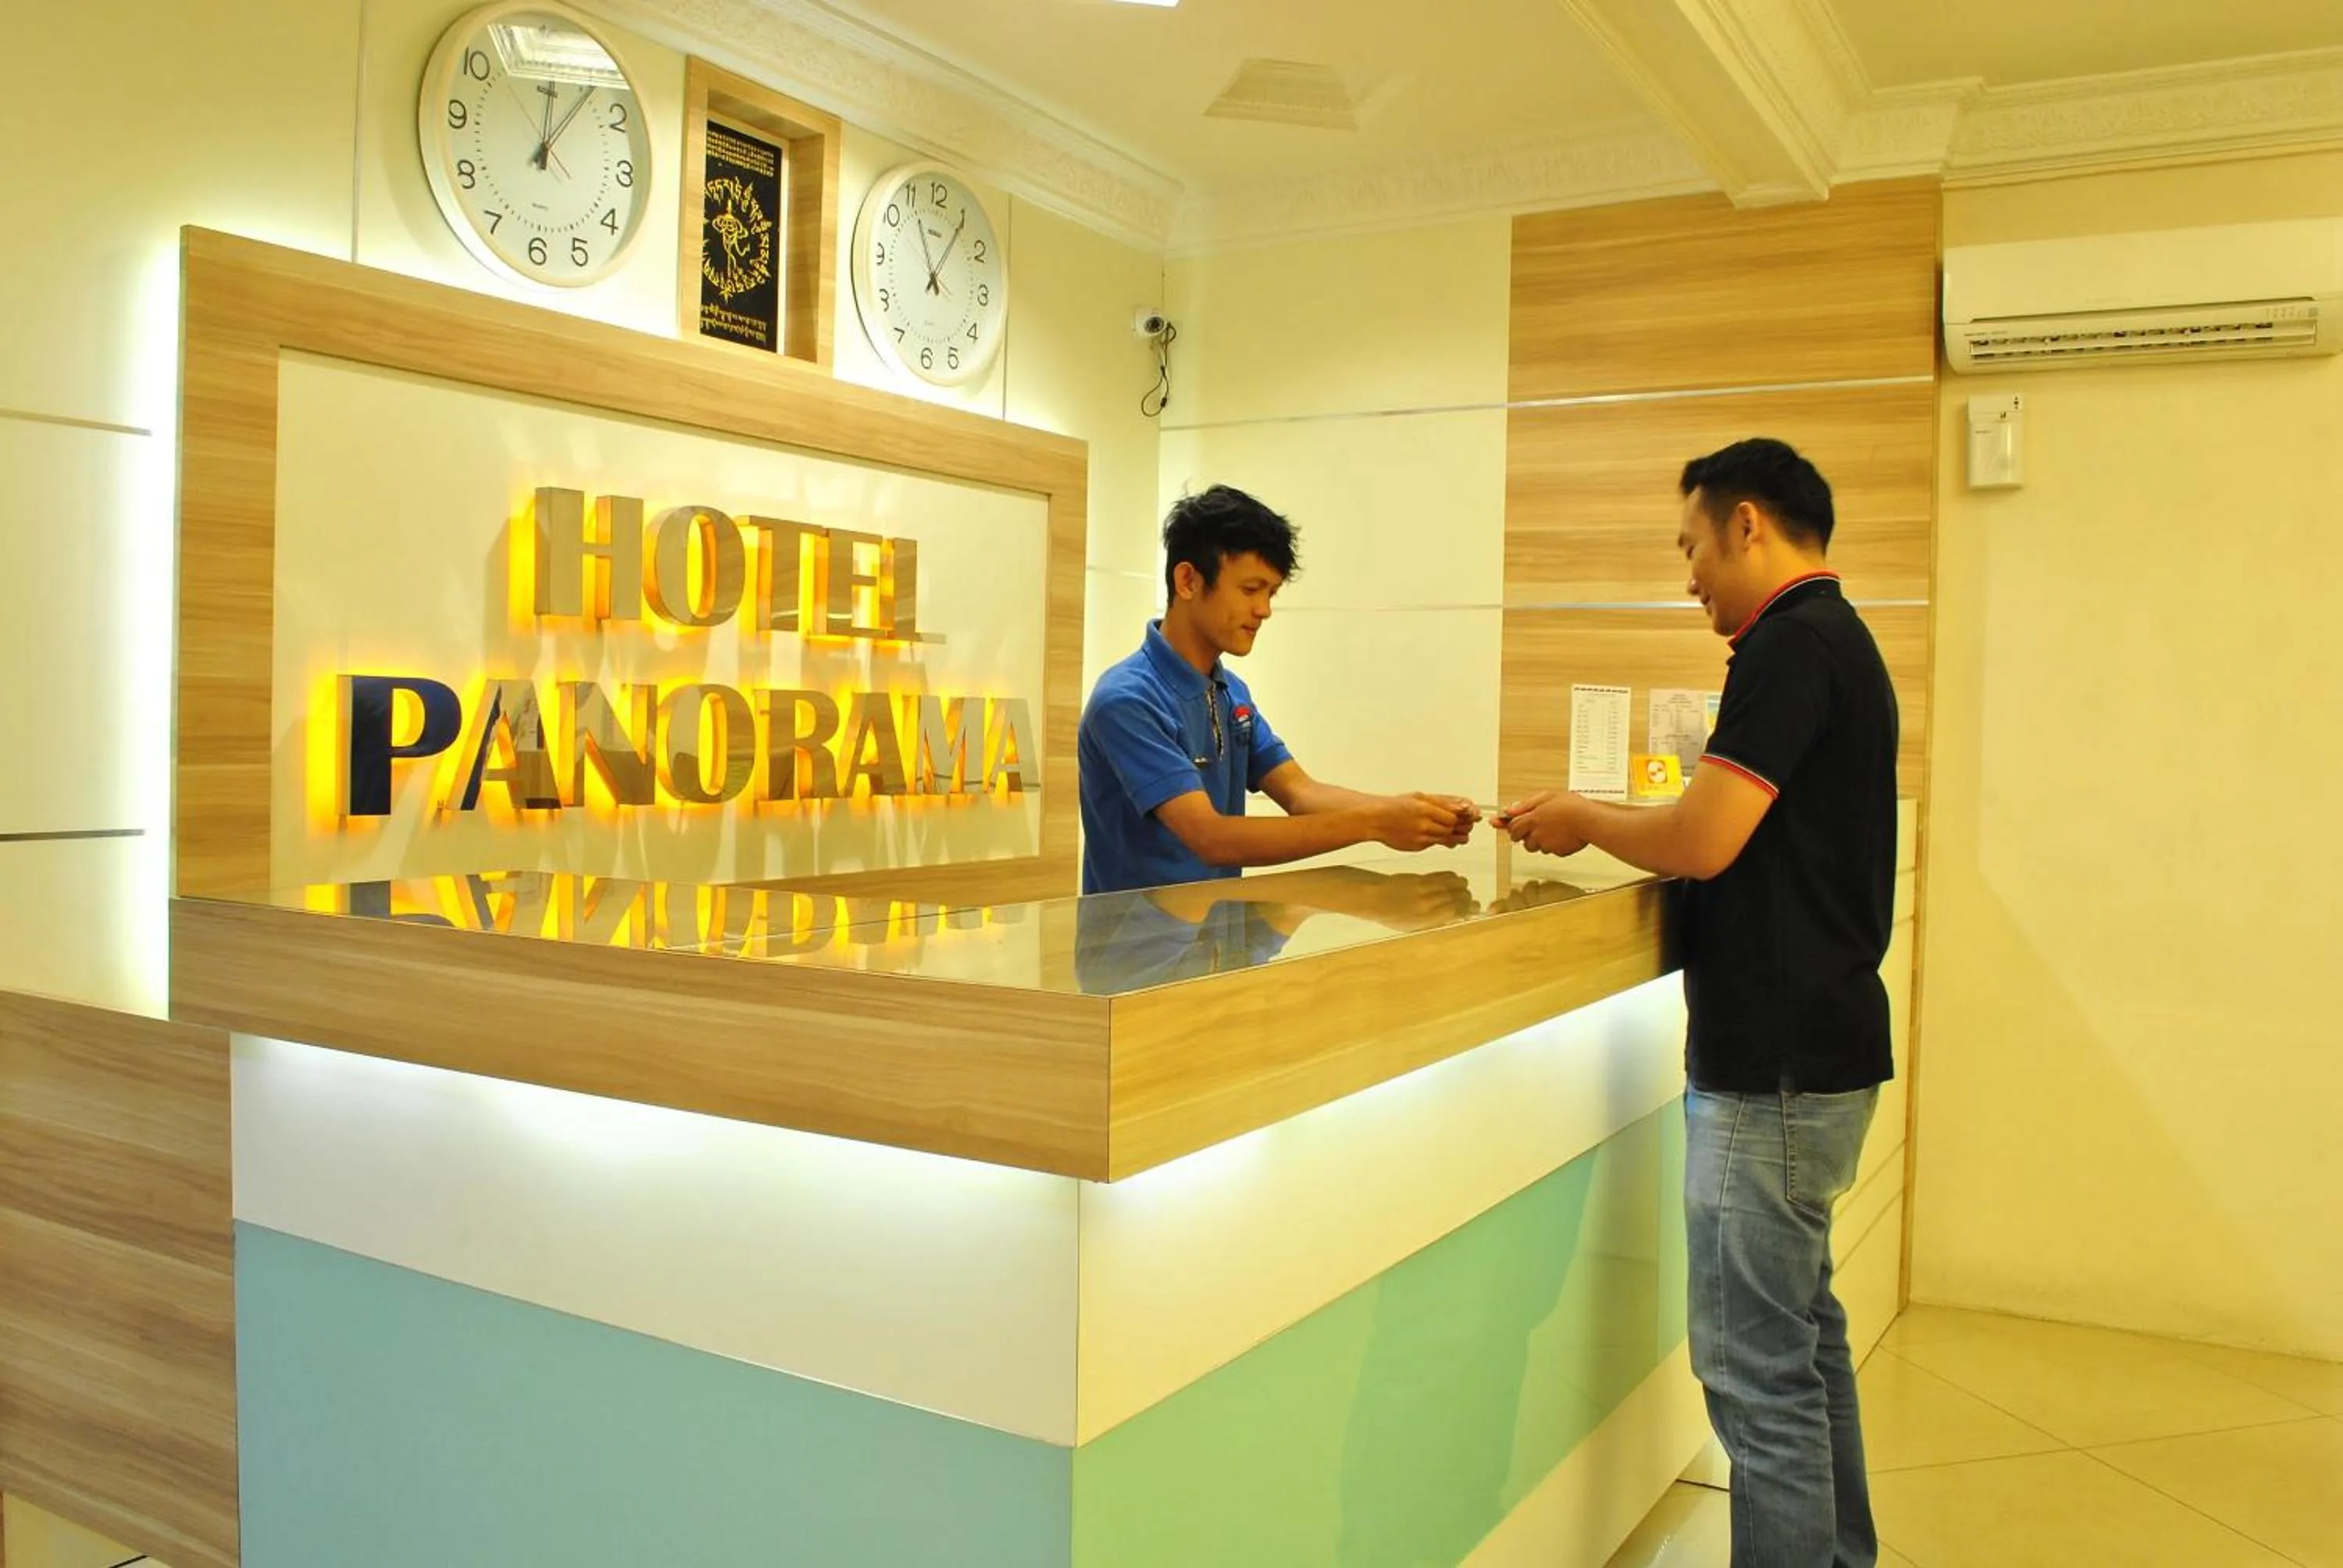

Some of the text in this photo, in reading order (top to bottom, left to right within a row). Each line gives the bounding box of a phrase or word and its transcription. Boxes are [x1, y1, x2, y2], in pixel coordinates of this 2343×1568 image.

[463, 47, 490, 81] 10
[448, 99, 467, 129] 9
[609, 103, 627, 133] 2
[457, 159, 476, 190] 8
[615, 160, 633, 187] 3
[906, 183, 916, 208] 11
[931, 181, 947, 209] 12
[483, 210, 502, 234] 7
[601, 208, 619, 236] 4
[528, 237, 547, 265] 6
[571, 237, 589, 266] 5
[974, 240, 986, 262] 2
[977, 284, 989, 307] 3
[893, 327, 905, 344] 7
[966, 323, 978, 344] 4
[921, 347, 933, 369] 6
[947, 347, 959, 369] 5
[536, 486, 947, 645] HOTEL
[337, 674, 1040, 816] PANORAMA
